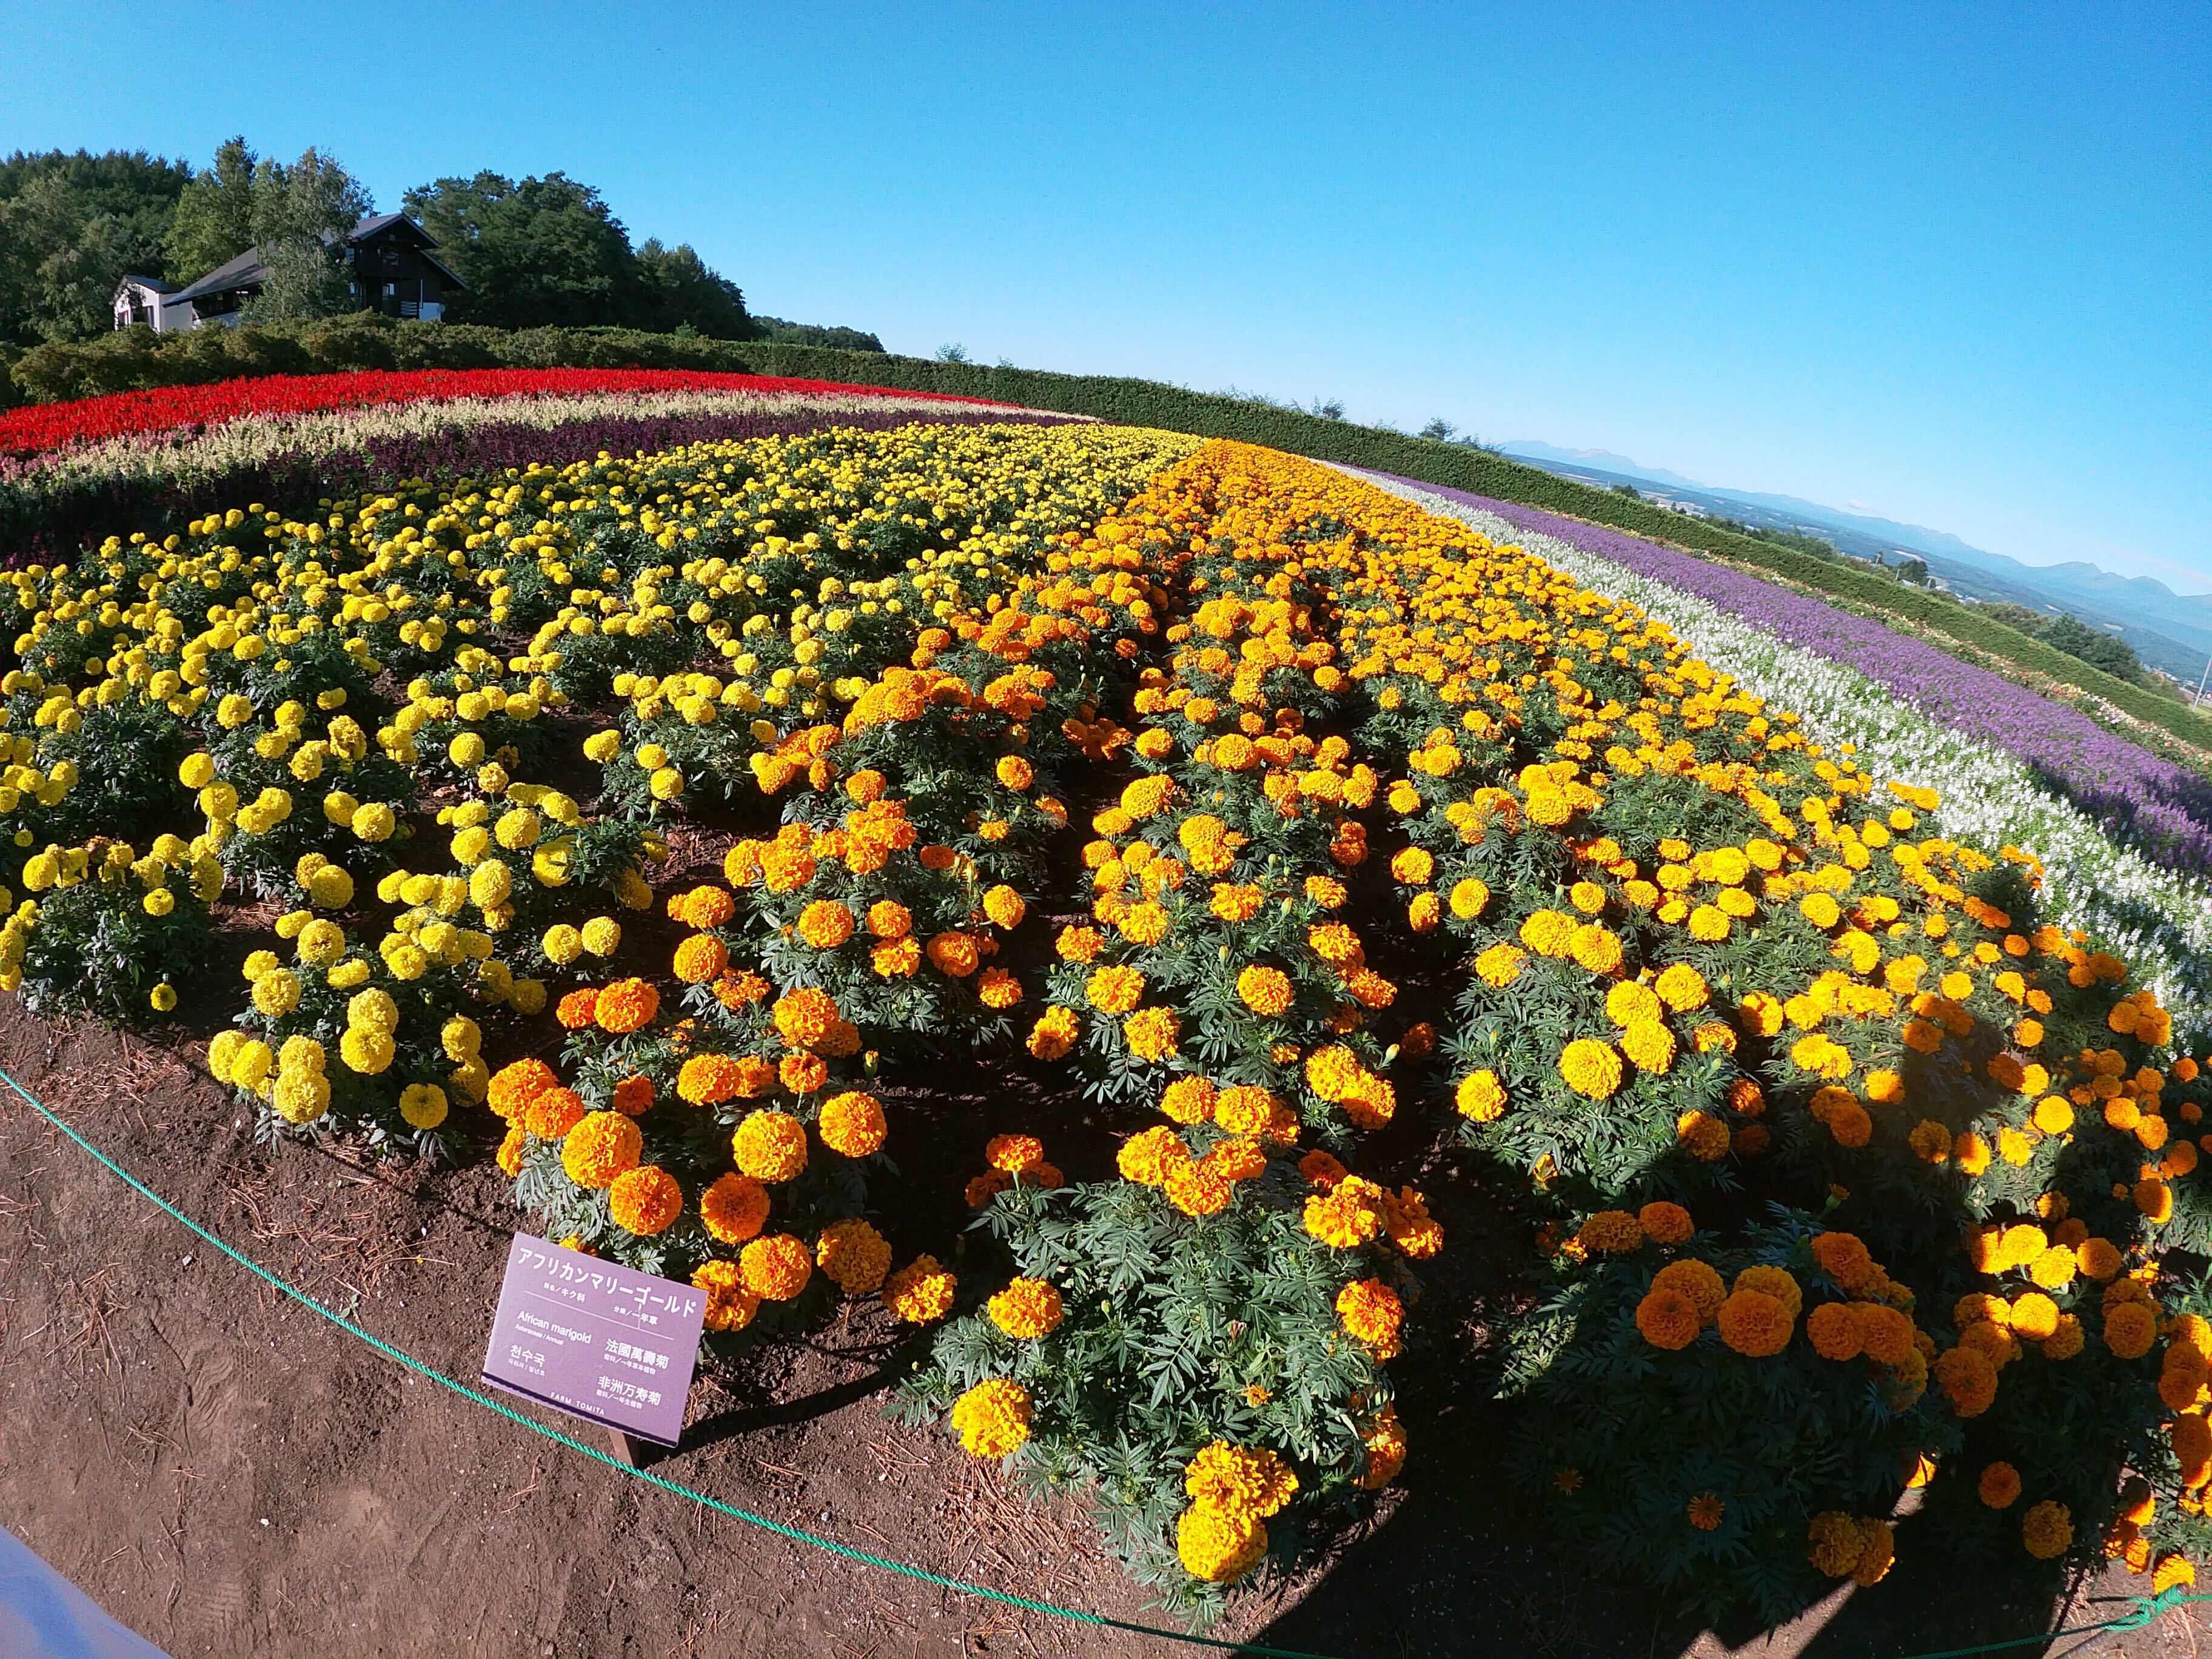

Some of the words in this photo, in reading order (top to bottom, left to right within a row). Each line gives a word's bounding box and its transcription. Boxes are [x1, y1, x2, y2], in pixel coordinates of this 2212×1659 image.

[517, 1247, 697, 1318] アフリカンマリーゴールド
[517, 1310, 550, 1330] African
[551, 1323, 592, 1344] marigold
[545, 1335, 564, 1346] Annual
[510, 1344, 545, 1367] 천수국
[550, 1392, 571, 1405] FARM
[576, 1400, 605, 1416] TOMITA
[597, 1375, 662, 1406] 非洲万寿菊
